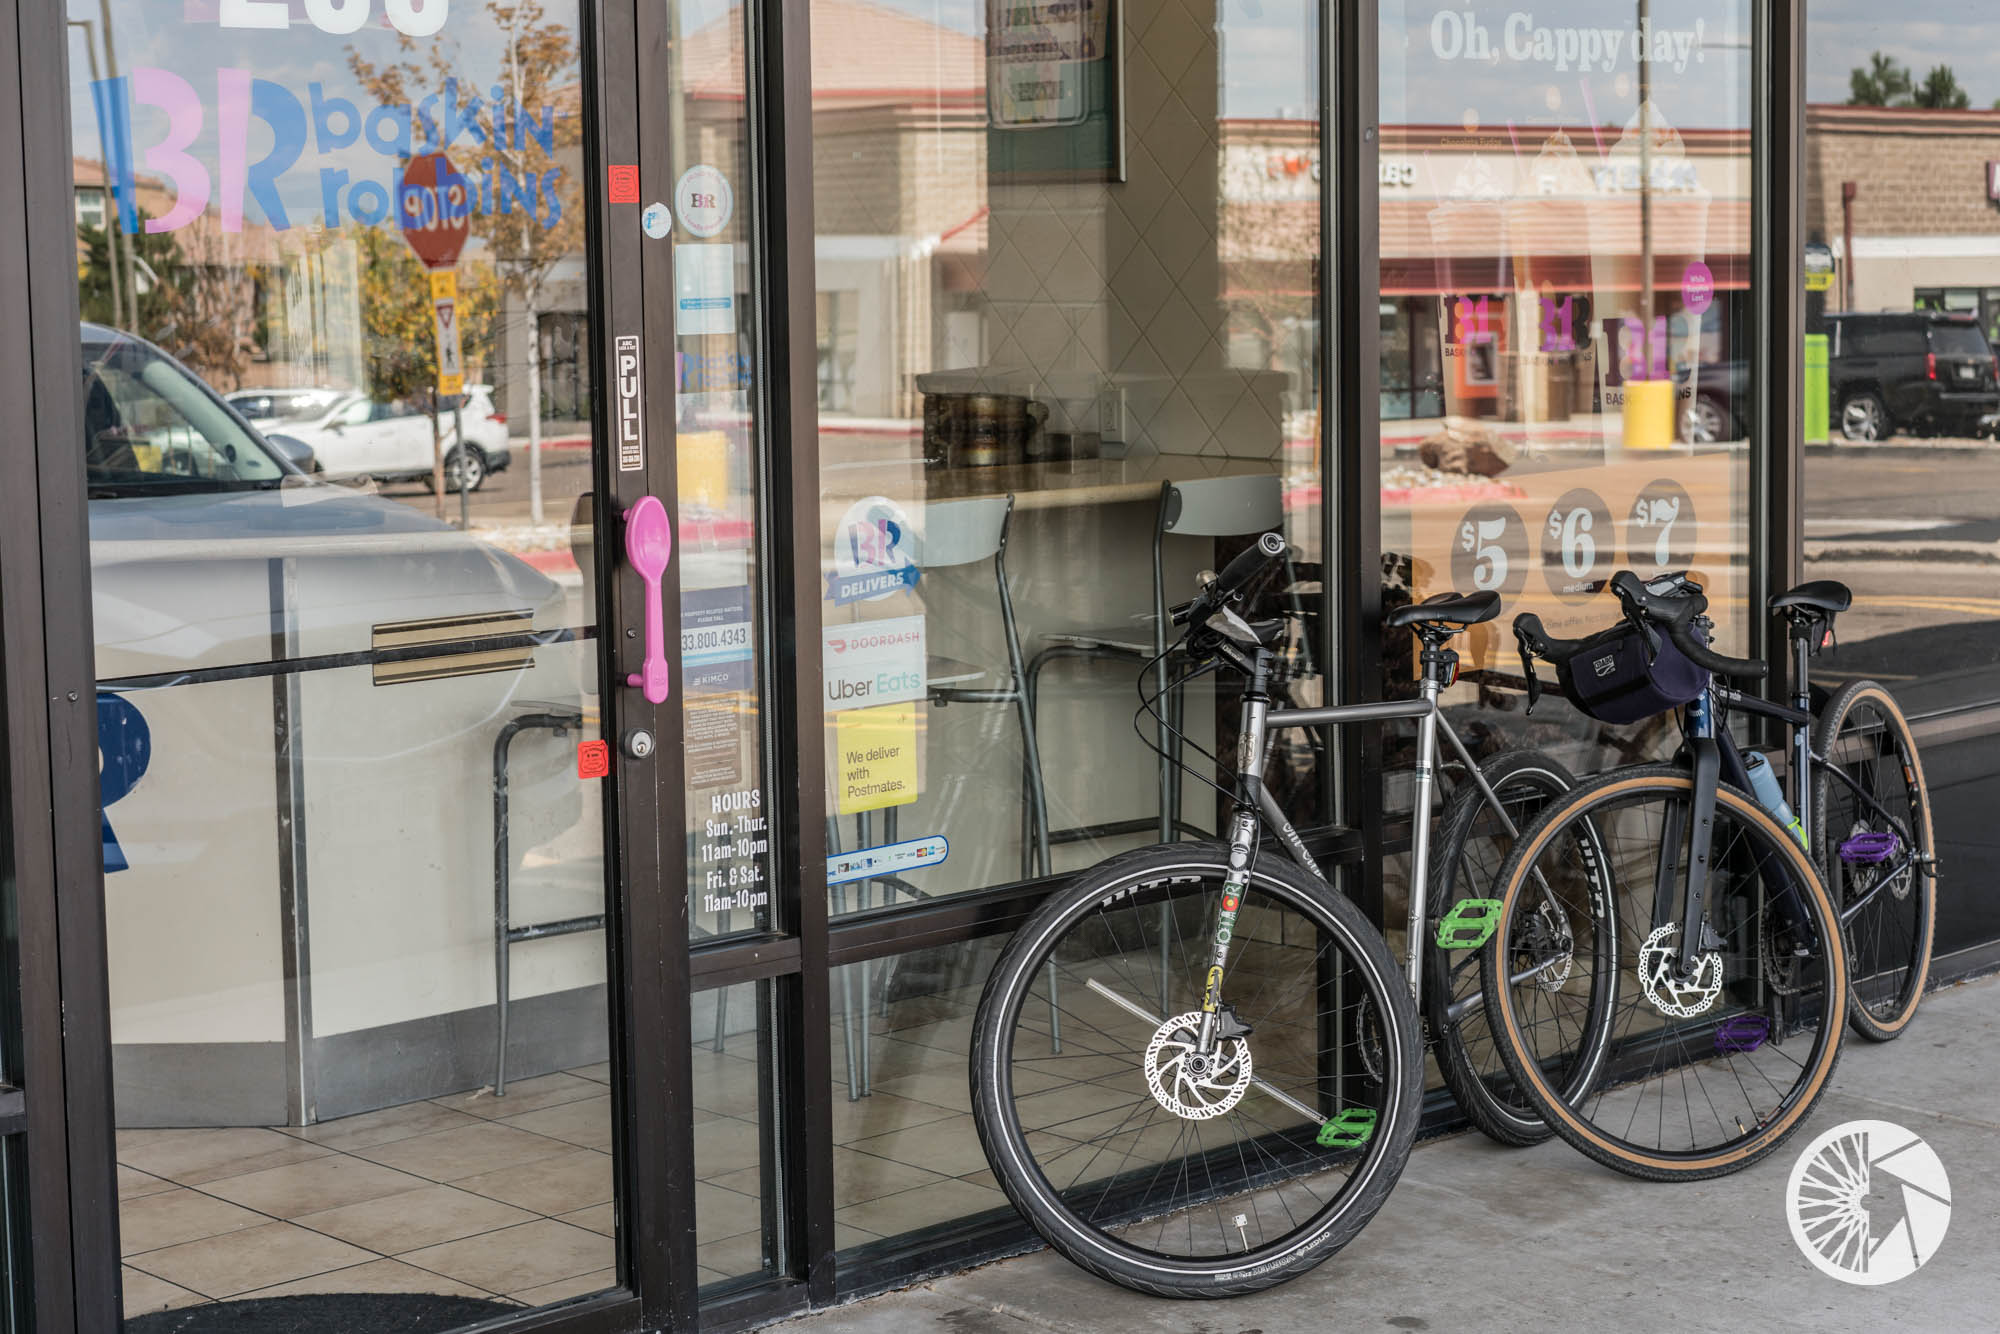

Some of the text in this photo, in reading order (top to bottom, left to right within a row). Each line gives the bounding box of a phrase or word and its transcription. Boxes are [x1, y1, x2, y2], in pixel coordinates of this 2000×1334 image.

[1430, 10, 1705, 74] Oh, Cappy day!
[620, 355, 638, 441] PULL
[1549, 507, 1596, 579] $6
[1636, 496, 1680, 567] $7
[1461, 517, 1508, 591] $5
[841, 572, 904, 598] DELIVERS
[1563, 582, 1594, 593] medium
[851, 632, 920, 650] DOORDASH
[702, 673, 729, 684] KIMCO
[828, 671, 921, 701] Uber Eats
[846, 746, 900, 764] We deliver
[847, 766, 870, 781] with
[847, 779, 906, 799] Postmates.
[711, 789, 760, 814] HOURS
[706, 815, 768, 838] Sun.-Thur.
[702, 838, 768, 862] 11am-10pm
[706, 866, 764, 889] Fri. & Sat.
[703, 889, 768, 912] 11am-10pm
